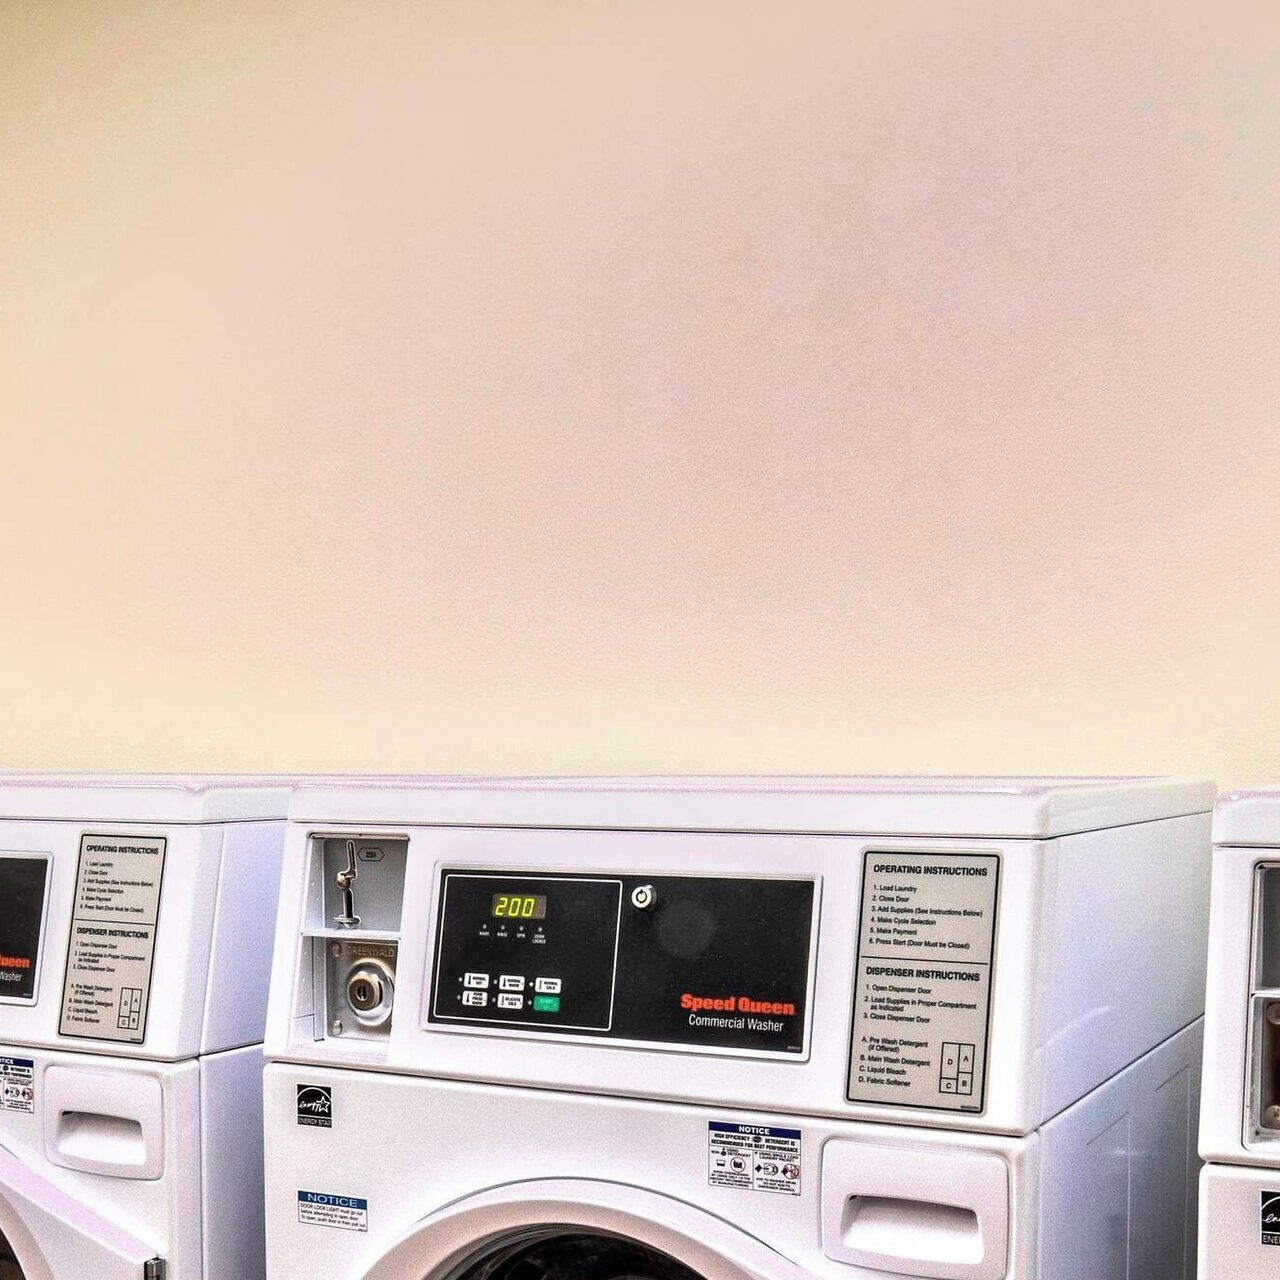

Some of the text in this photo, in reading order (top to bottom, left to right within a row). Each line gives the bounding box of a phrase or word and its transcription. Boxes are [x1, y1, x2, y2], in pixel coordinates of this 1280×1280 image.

[86, 845, 158, 855] OPERATING INSTRUCTIONS
[873, 865, 987, 876] OPERATING INSTRUCTIONS
[495, 897, 534, 917] 200
[77, 928, 148, 938] DISPENSER INSTRUCTIONS
[0, 971, 21, 981] Washer
[866, 966, 980, 982] DISPENSER INSTRUCTIONS
[681, 994, 795, 1015] Speed Queen
[689, 1014, 784, 1031] Commercial Washer
[739, 1126, 770, 1135] NOTICE
[308, 1194, 358, 1208] NOTICE
